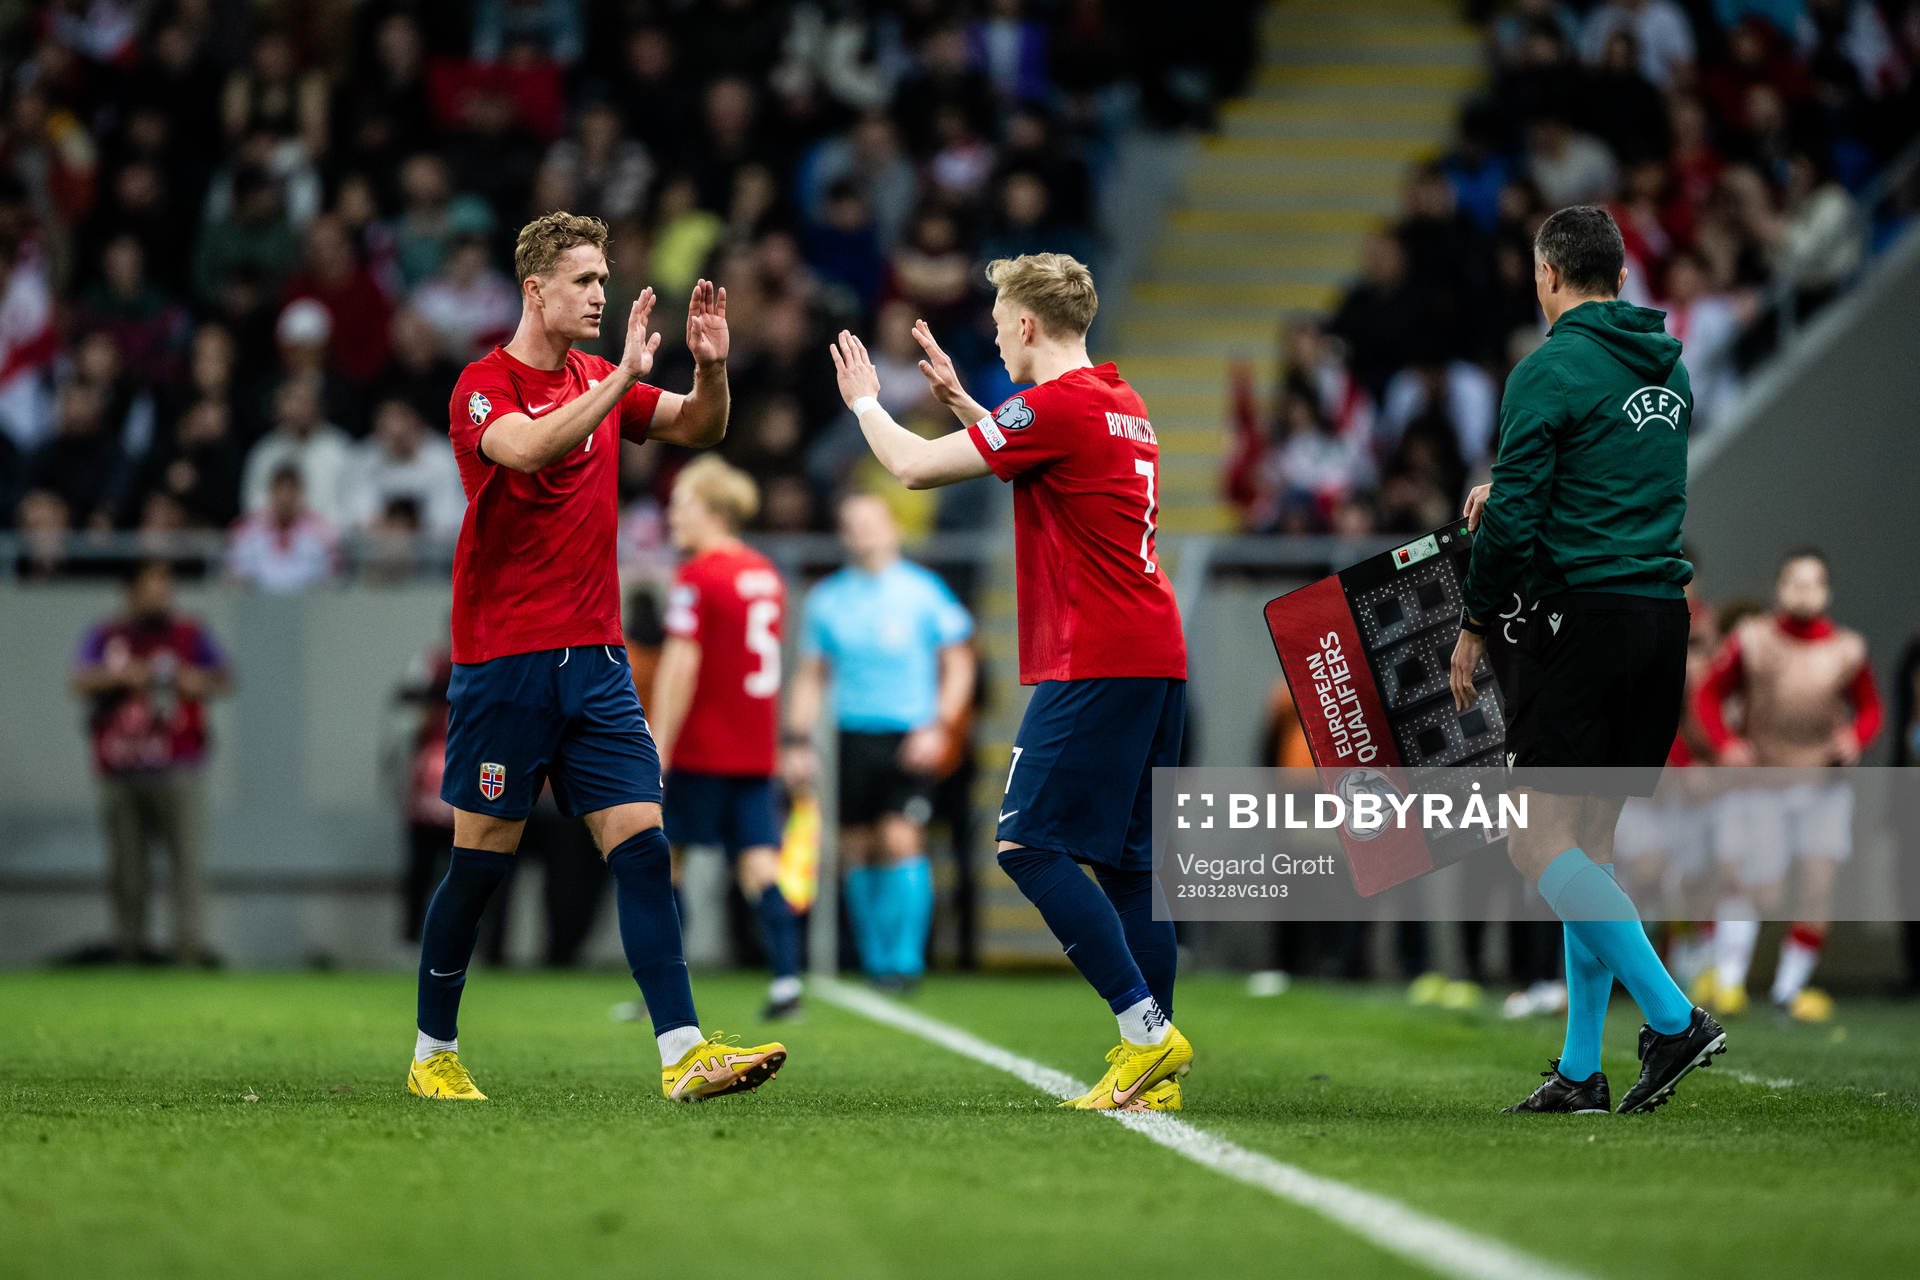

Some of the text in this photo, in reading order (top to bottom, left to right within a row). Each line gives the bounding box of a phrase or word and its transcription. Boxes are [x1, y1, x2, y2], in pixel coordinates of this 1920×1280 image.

[1627, 393, 1681, 425] UEFA
[1135, 458, 1155, 574] 7
[743, 600, 782, 698] 5
[1320, 631, 1378, 763] QUALIFIERS
[1306, 652, 1353, 759] EUROPEAN
